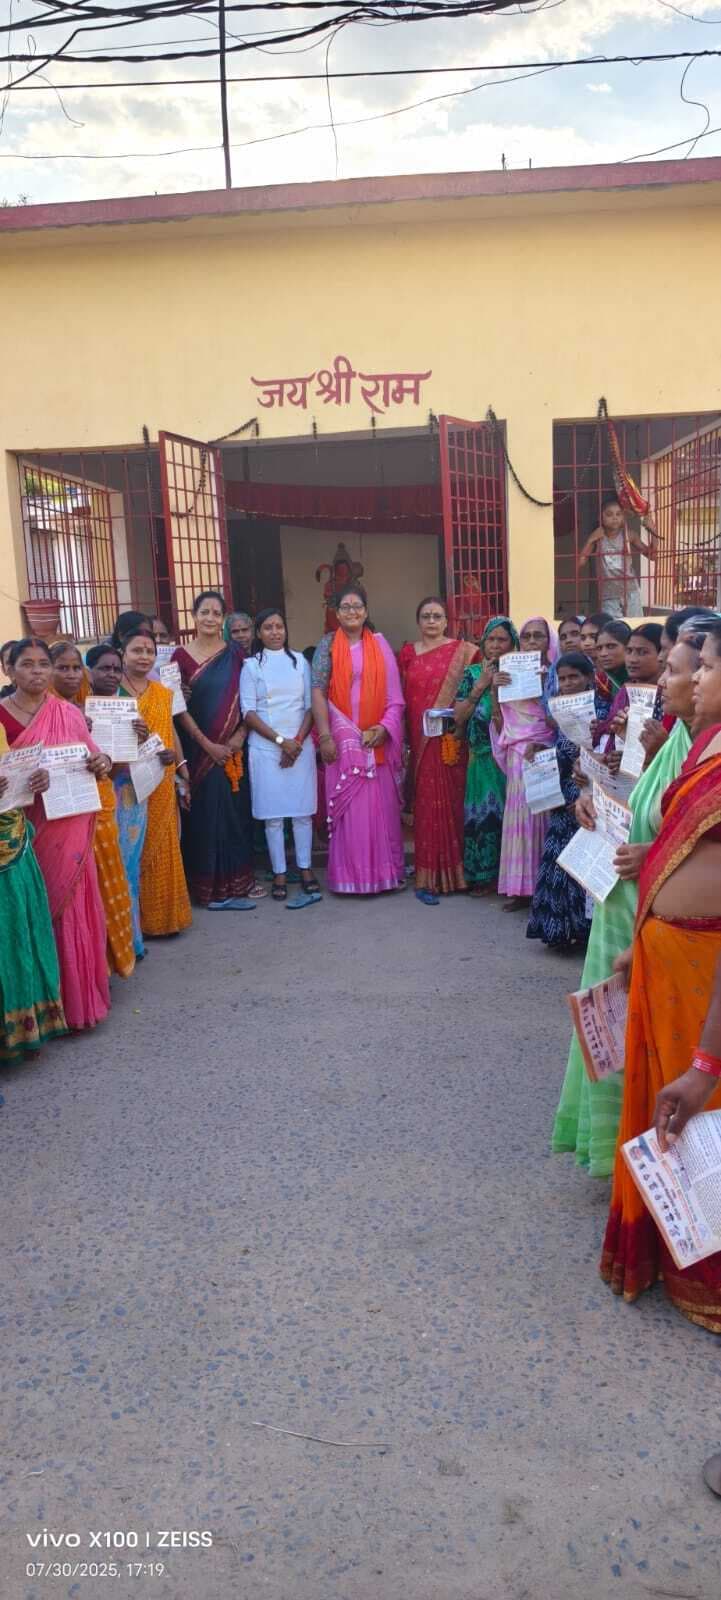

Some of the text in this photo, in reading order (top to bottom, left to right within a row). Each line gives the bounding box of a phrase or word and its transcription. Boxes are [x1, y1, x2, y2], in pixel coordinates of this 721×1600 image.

[250, 355, 432, 414] जय श्री राम
